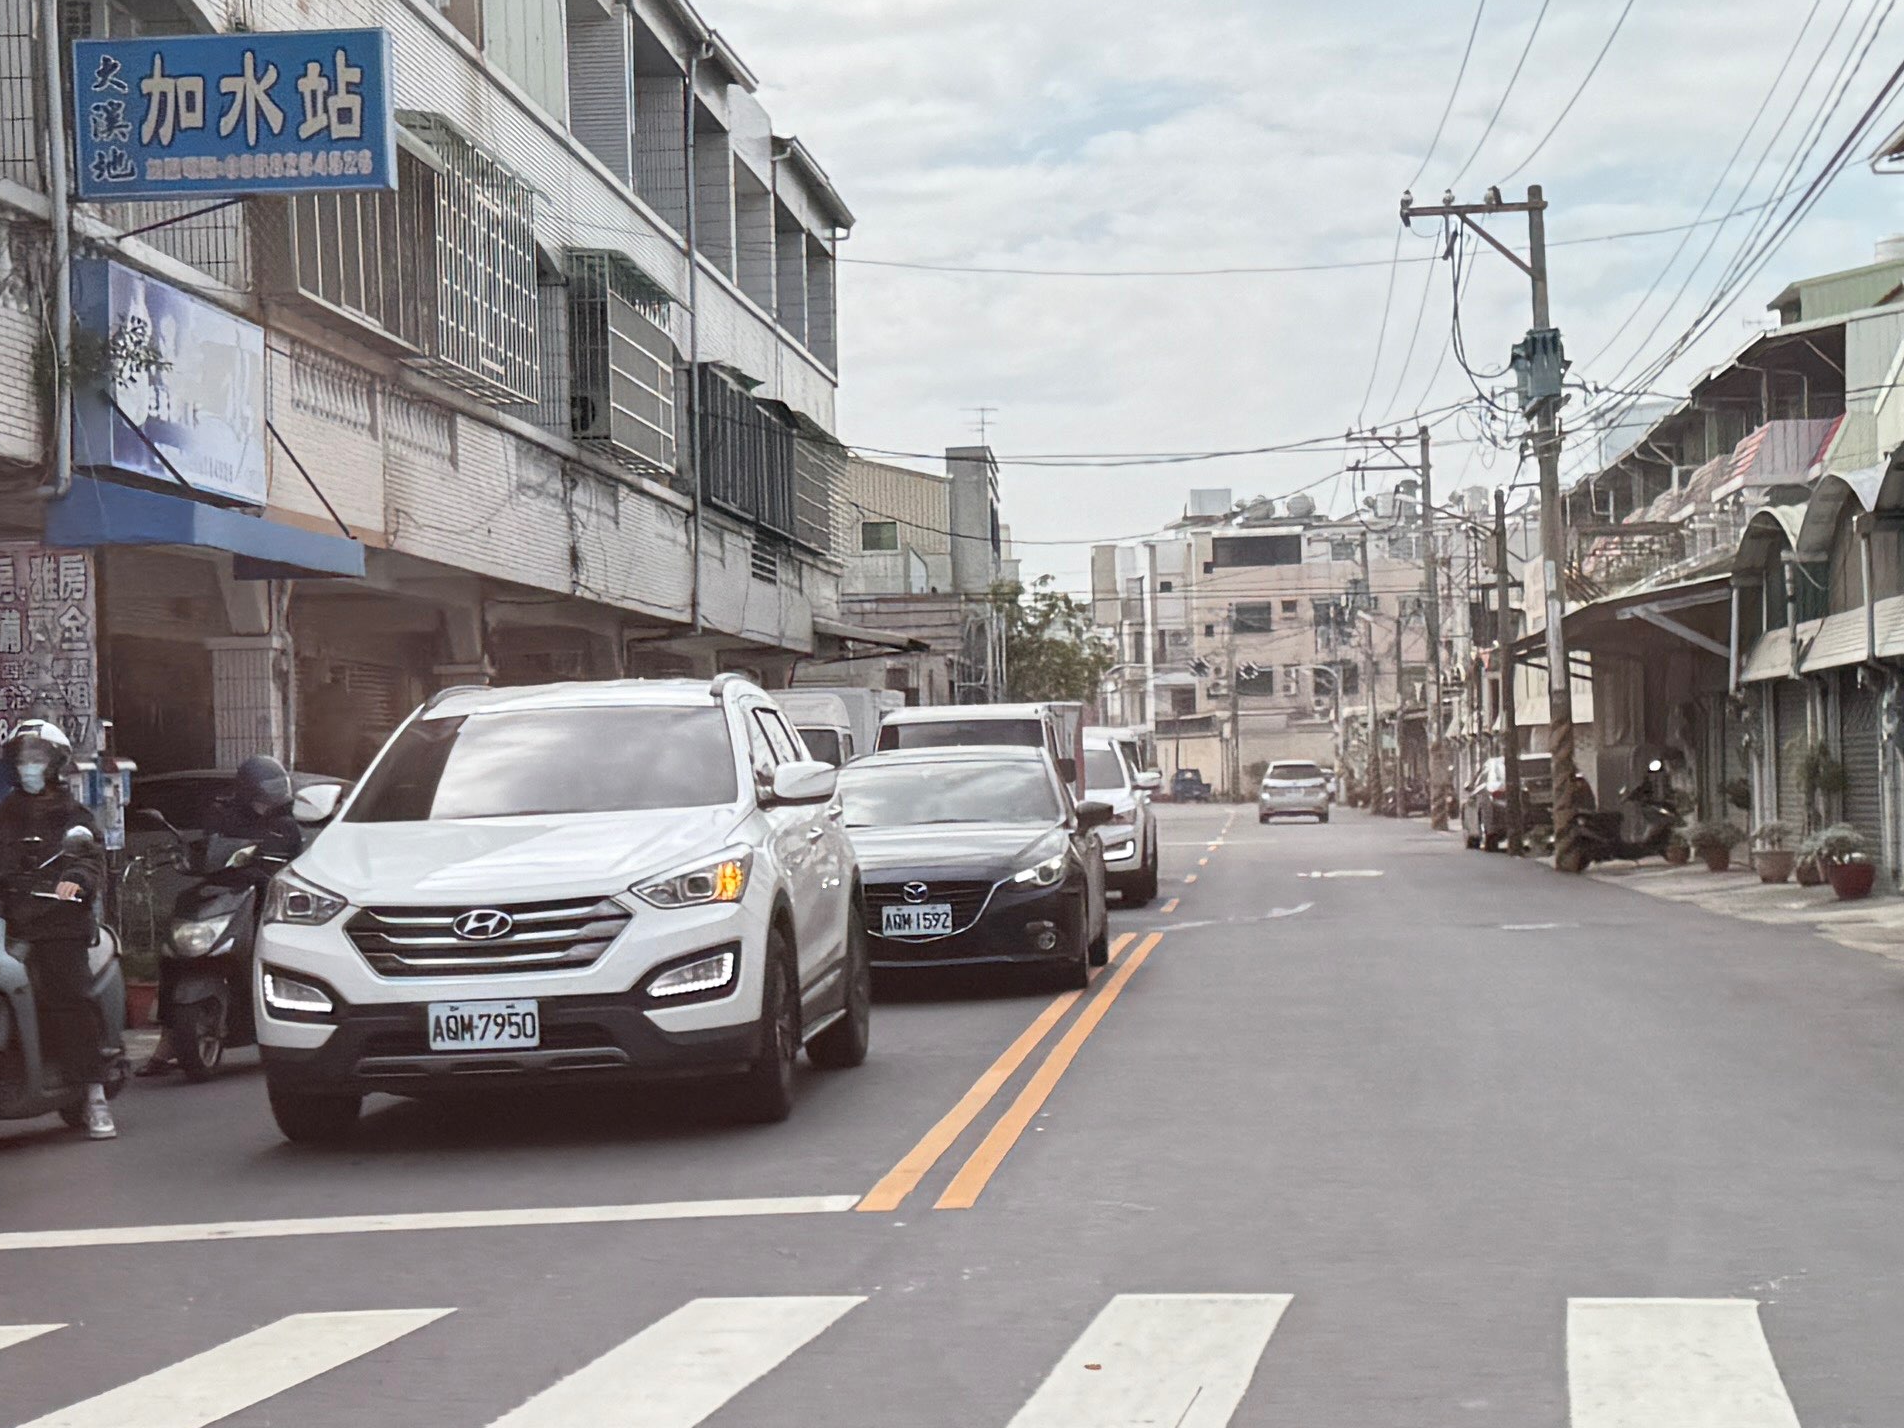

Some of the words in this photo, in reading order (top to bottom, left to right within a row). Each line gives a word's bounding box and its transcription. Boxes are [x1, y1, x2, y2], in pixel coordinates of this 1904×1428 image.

[140, 47, 363, 147] 加水站
[432, 1011, 536, 1043] AQM-7950
